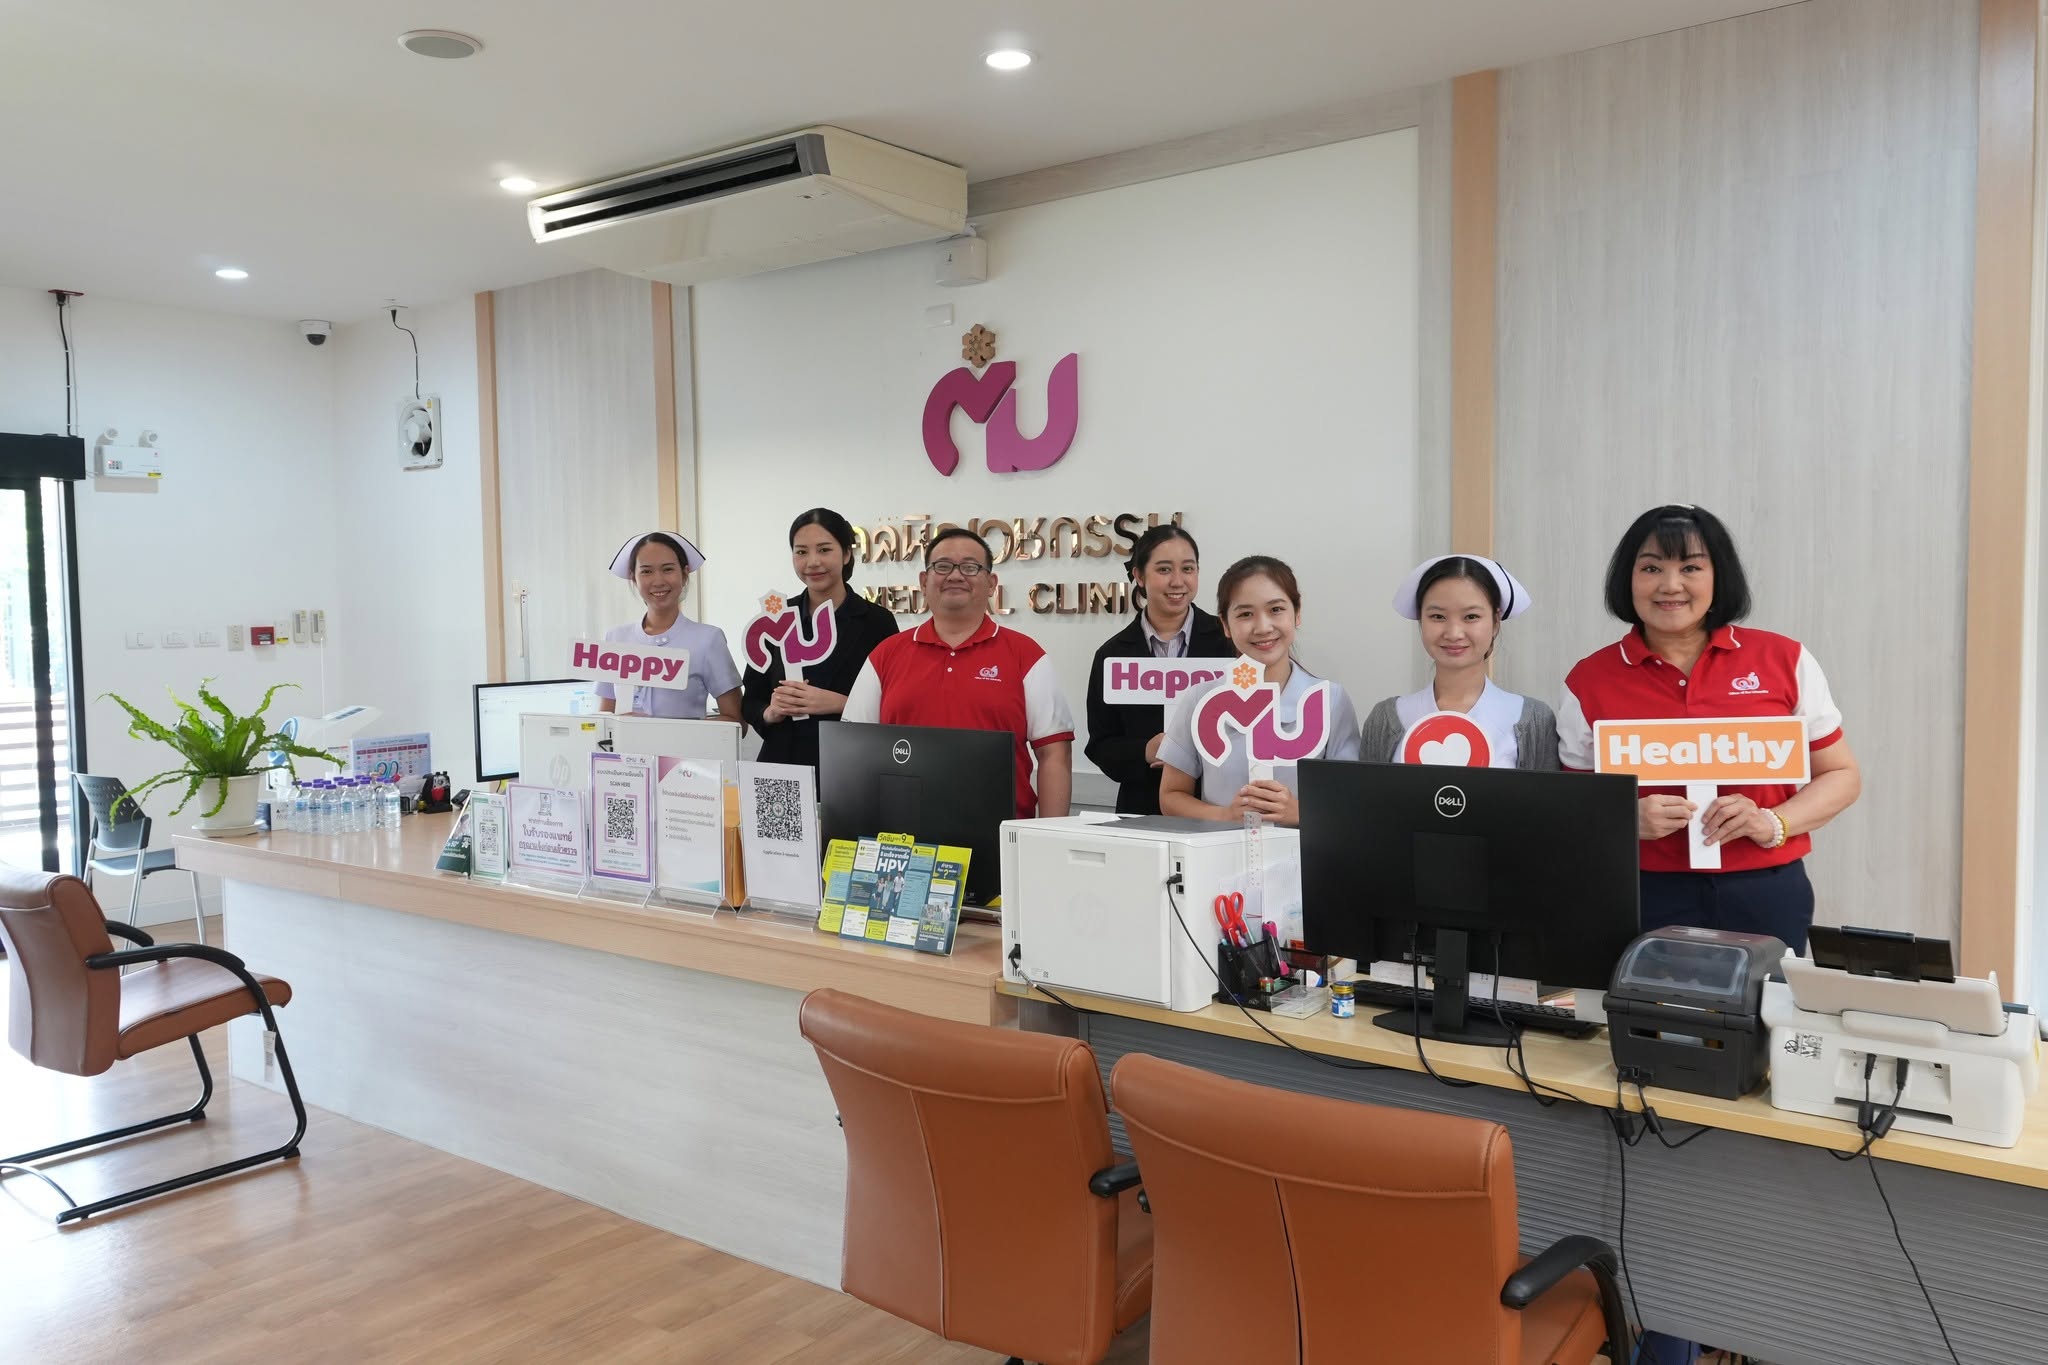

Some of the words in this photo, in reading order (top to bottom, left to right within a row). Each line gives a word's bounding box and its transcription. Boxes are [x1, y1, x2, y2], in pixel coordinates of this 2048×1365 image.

[573, 643, 684, 681] Happy
[895, 747, 909, 755] DELL
[1609, 732, 1796, 769] Healthy
[1438, 796, 1463, 806] DELL
[876, 857, 908, 873] HPV
